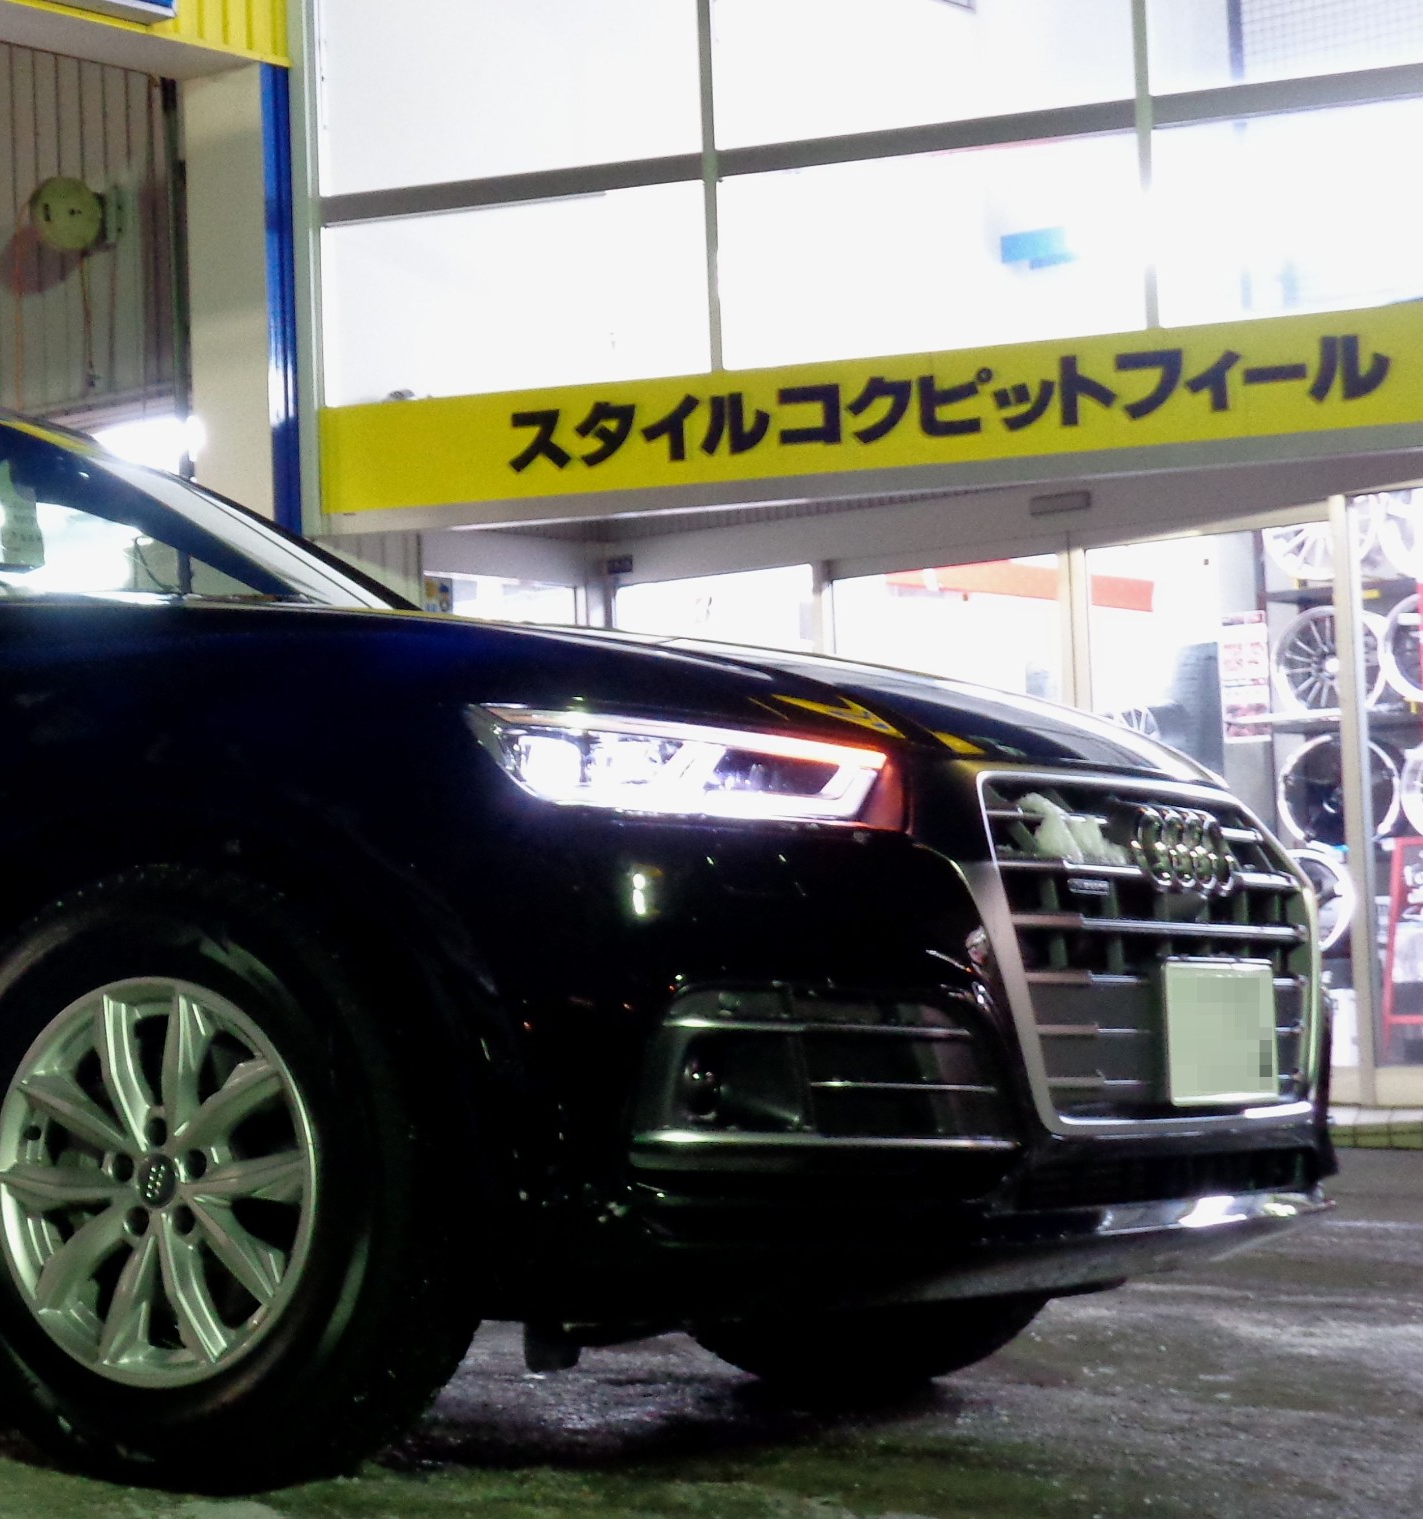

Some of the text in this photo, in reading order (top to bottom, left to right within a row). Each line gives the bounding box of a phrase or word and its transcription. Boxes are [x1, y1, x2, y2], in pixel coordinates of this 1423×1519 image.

[507, 334, 1390, 474] スタイルコクピットフィール
